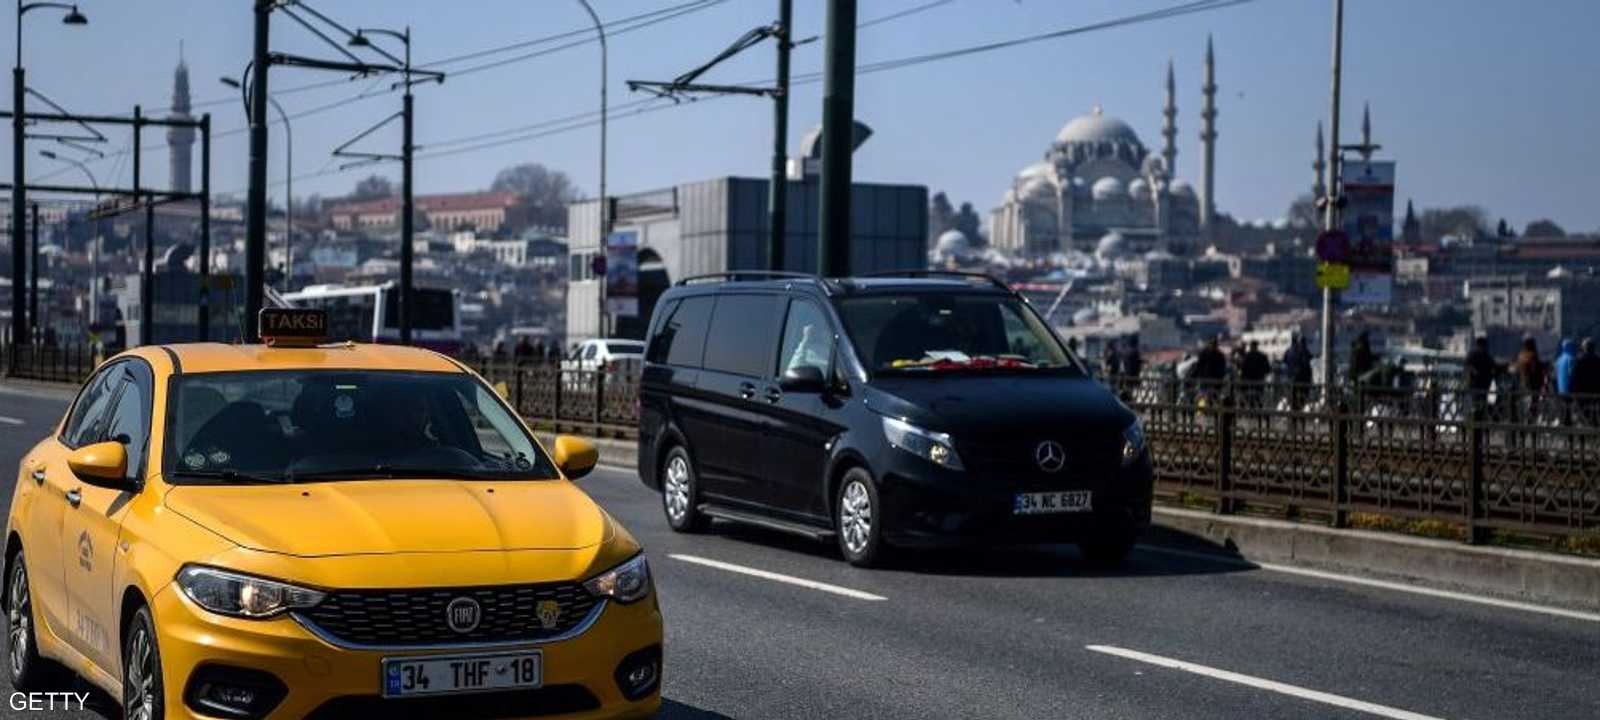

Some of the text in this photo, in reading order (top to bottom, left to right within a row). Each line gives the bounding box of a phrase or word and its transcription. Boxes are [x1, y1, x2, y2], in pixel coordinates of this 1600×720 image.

[455, 607, 474, 624] FIAT
[402, 658, 534, 690] 34 THF 18
